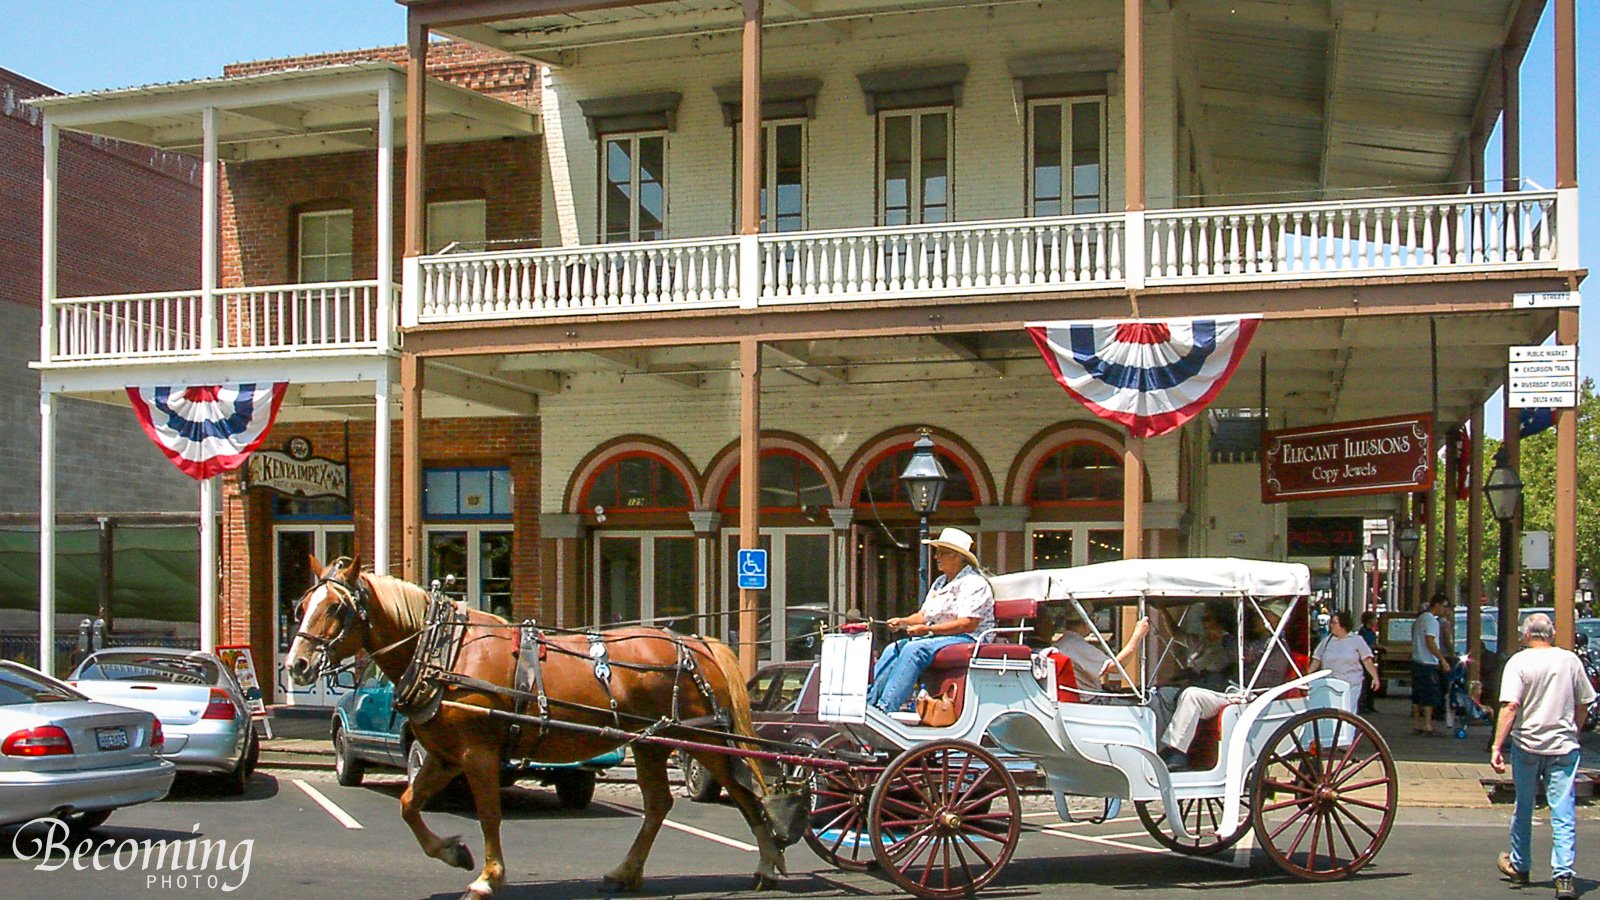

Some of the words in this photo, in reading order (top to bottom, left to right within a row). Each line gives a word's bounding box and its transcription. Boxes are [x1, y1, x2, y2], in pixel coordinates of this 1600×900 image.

[1528, 294, 1535, 306] J
[1542, 293, 1565, 301] STREET
[1282, 443, 1338, 464] ELEGANT
[1344, 435, 1411, 459] ILLUSIONS
[1312, 465, 1339, 483] Copy
[1342, 462, 1378, 478] Jewels
